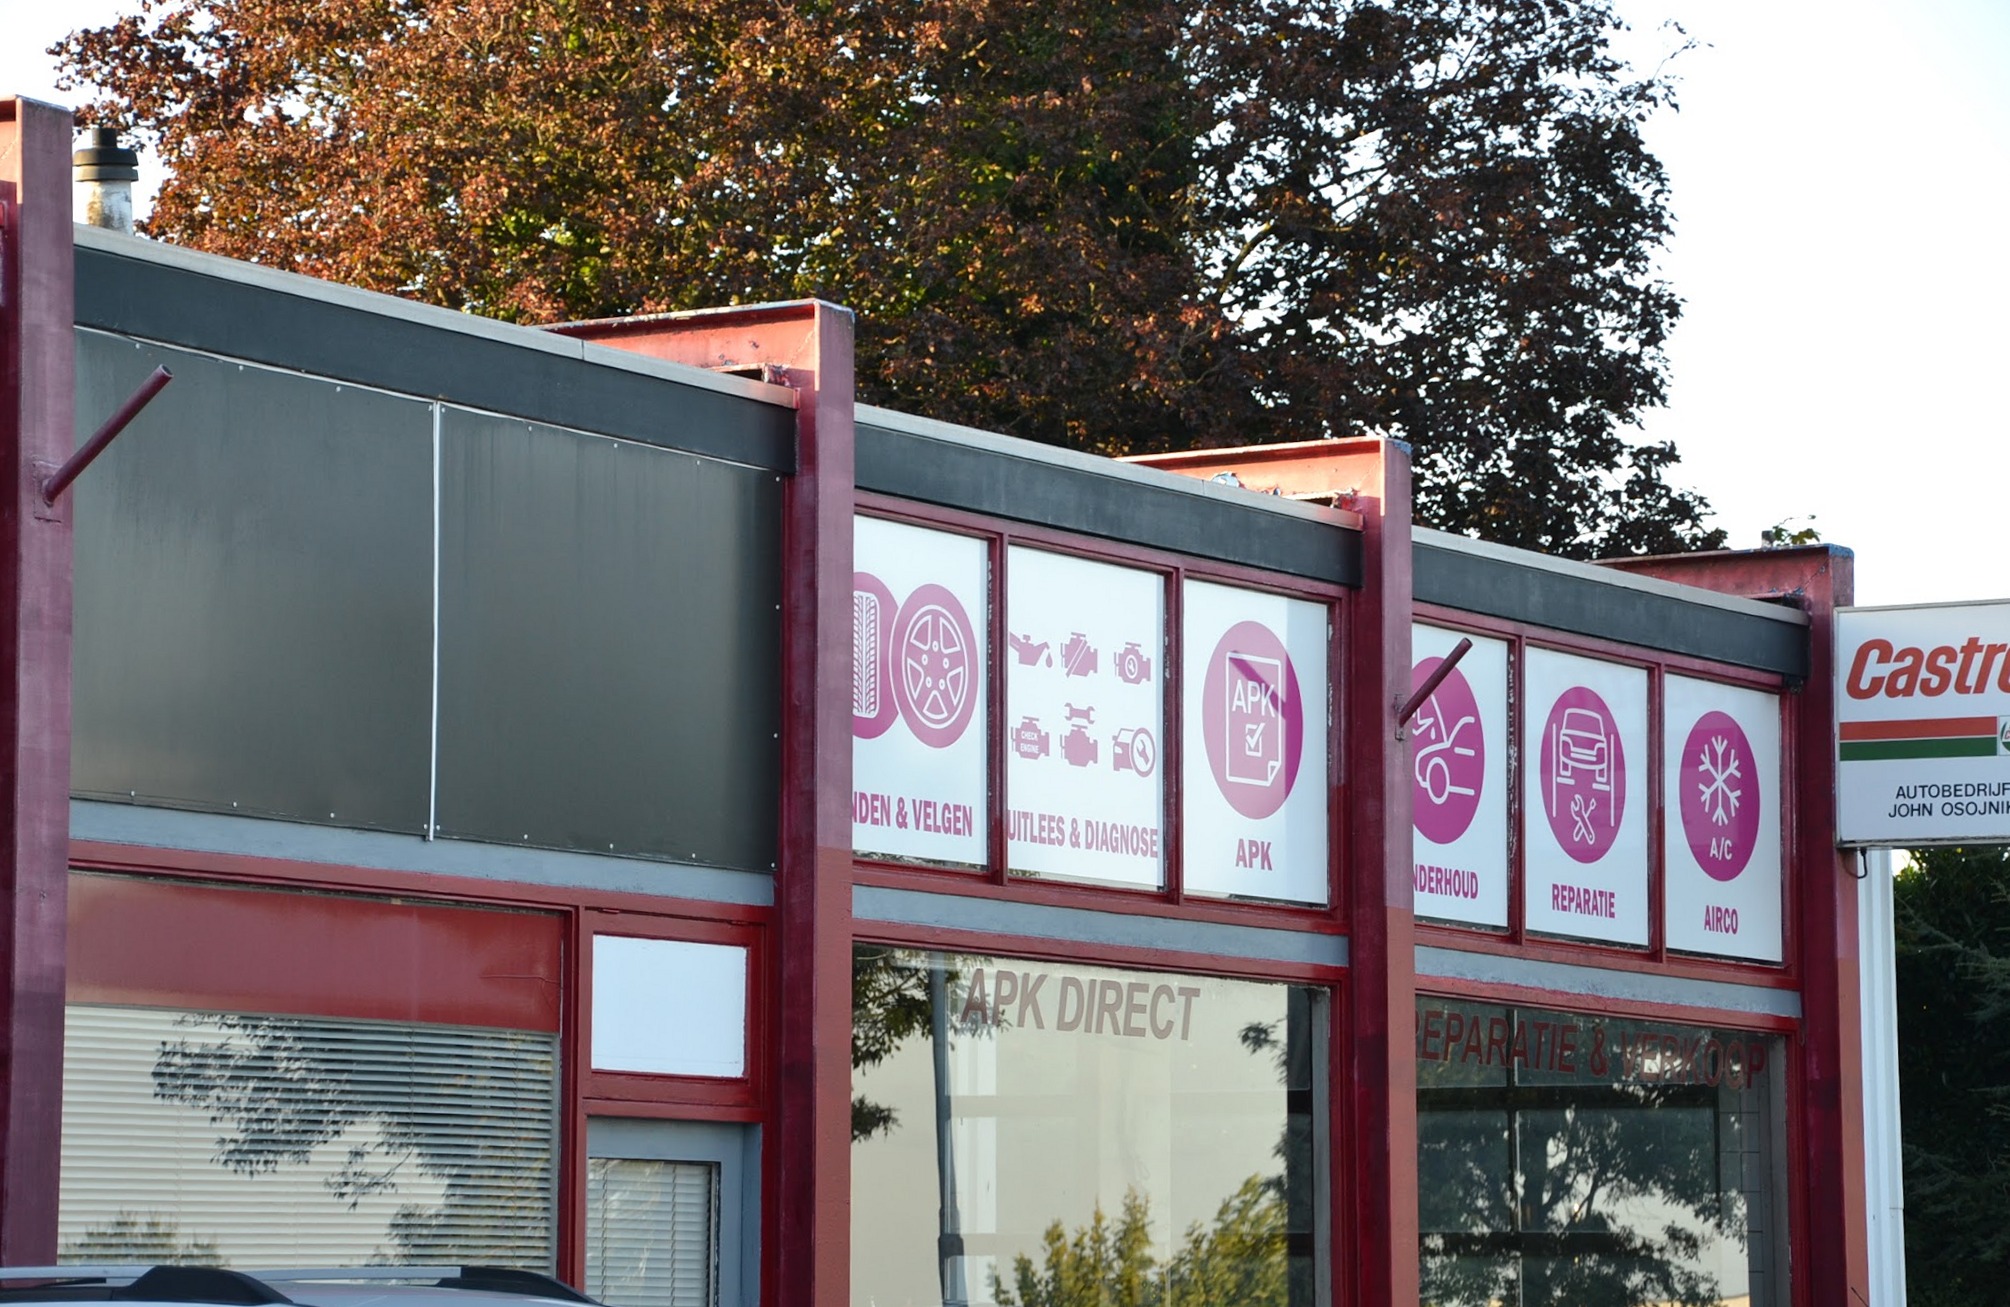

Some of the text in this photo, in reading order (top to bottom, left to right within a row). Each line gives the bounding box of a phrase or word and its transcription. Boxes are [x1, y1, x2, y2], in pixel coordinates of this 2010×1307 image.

[1231, 679, 1277, 719] APK
[1020, 730, 1039, 741] CHECK
[1020, 742, 1040, 754] ENGINE
[1896, 782, 2010, 800] AUTOBEDRIJF
[895, 796, 908, 830] &
[911, 798, 973, 837] VELGEN
[1888, 803, 1933, 818] JOHN
[1007, 809, 1158, 858] UITLEES & DIAGNOSE
[1709, 837, 1733, 861] A/C
[1235, 838, 1273, 871] APK
[1552, 883, 1616, 919] REPARATIE
[1704, 904, 1738, 935] AIRCO
[960, 968, 1201, 1041] APK DIRECT
[1415, 1009, 1767, 1089] EPARATIE & VERKOOP
